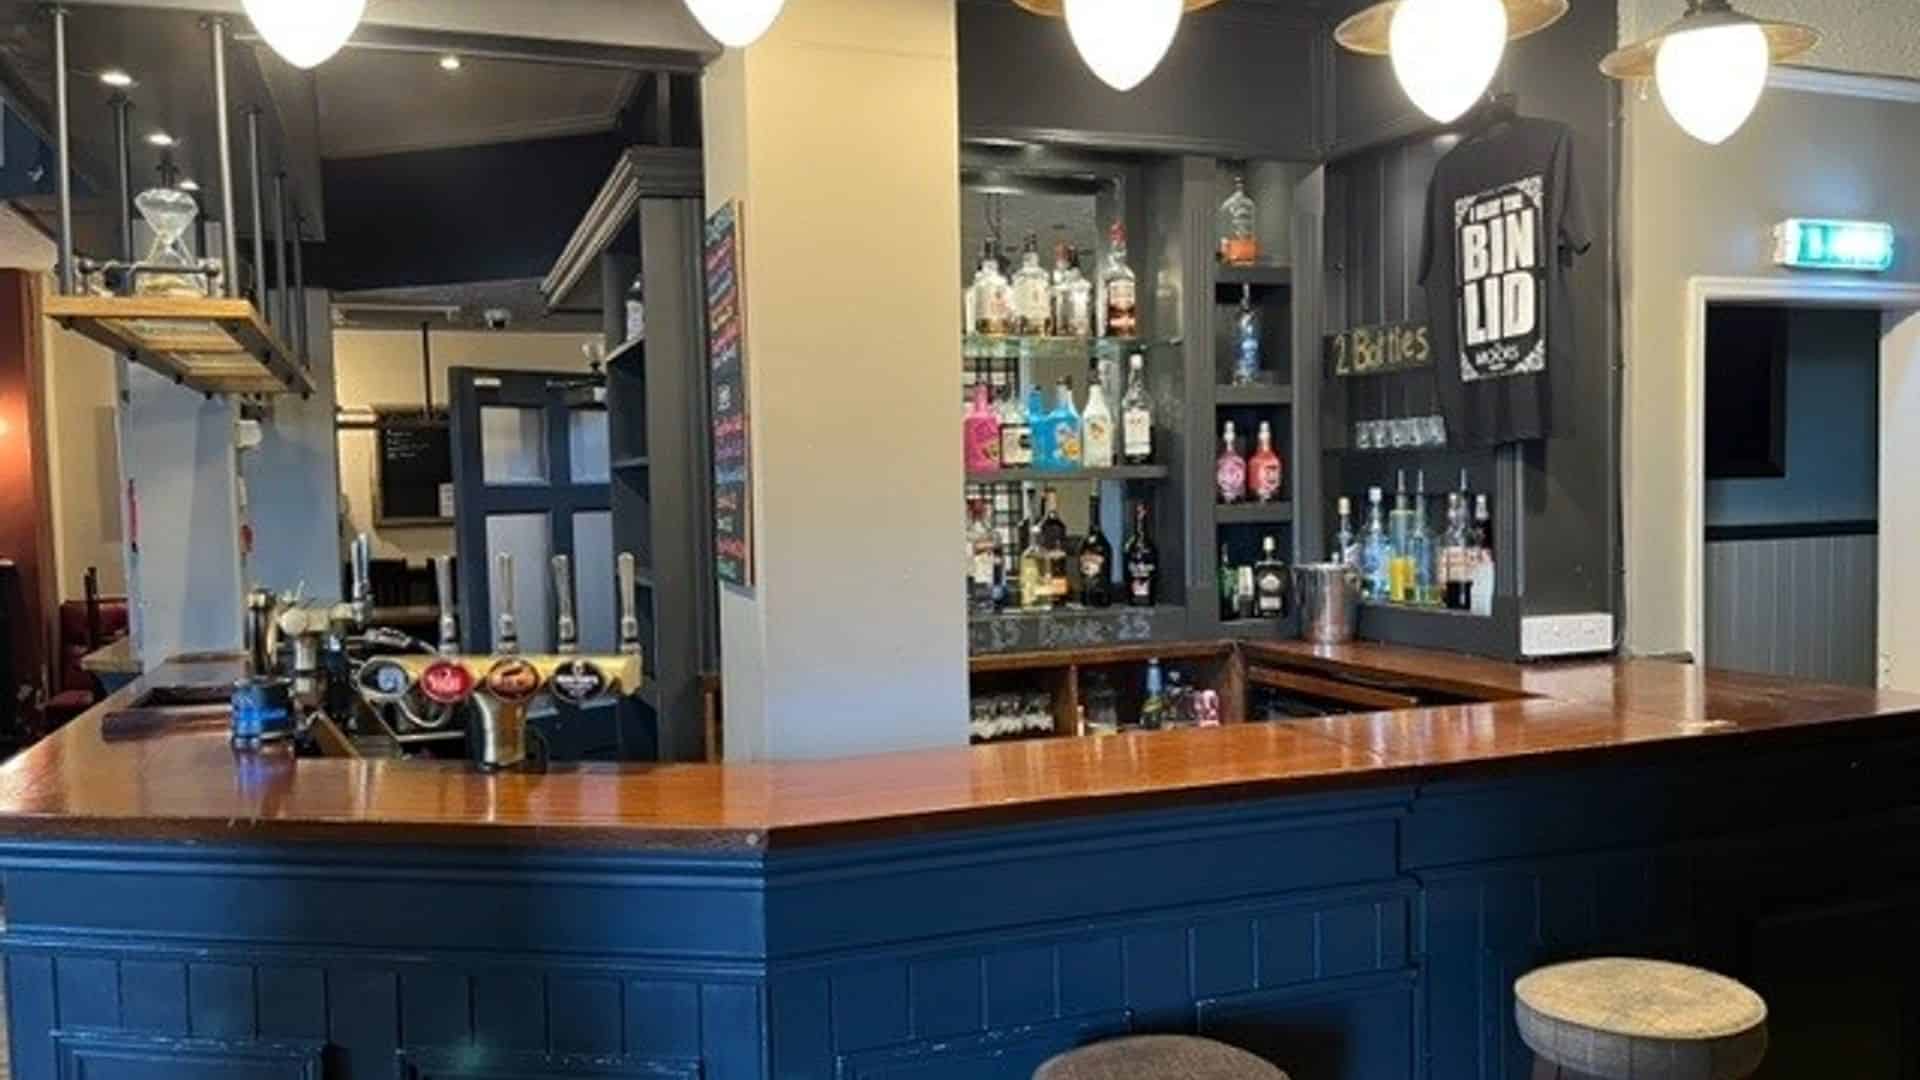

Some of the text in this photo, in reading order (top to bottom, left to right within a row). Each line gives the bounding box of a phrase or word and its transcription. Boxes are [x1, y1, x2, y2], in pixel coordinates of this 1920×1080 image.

[1462, 209, 1535, 281] BIN
[1464, 271, 1536, 345] LID
[1335, 335, 1349, 376] 2
